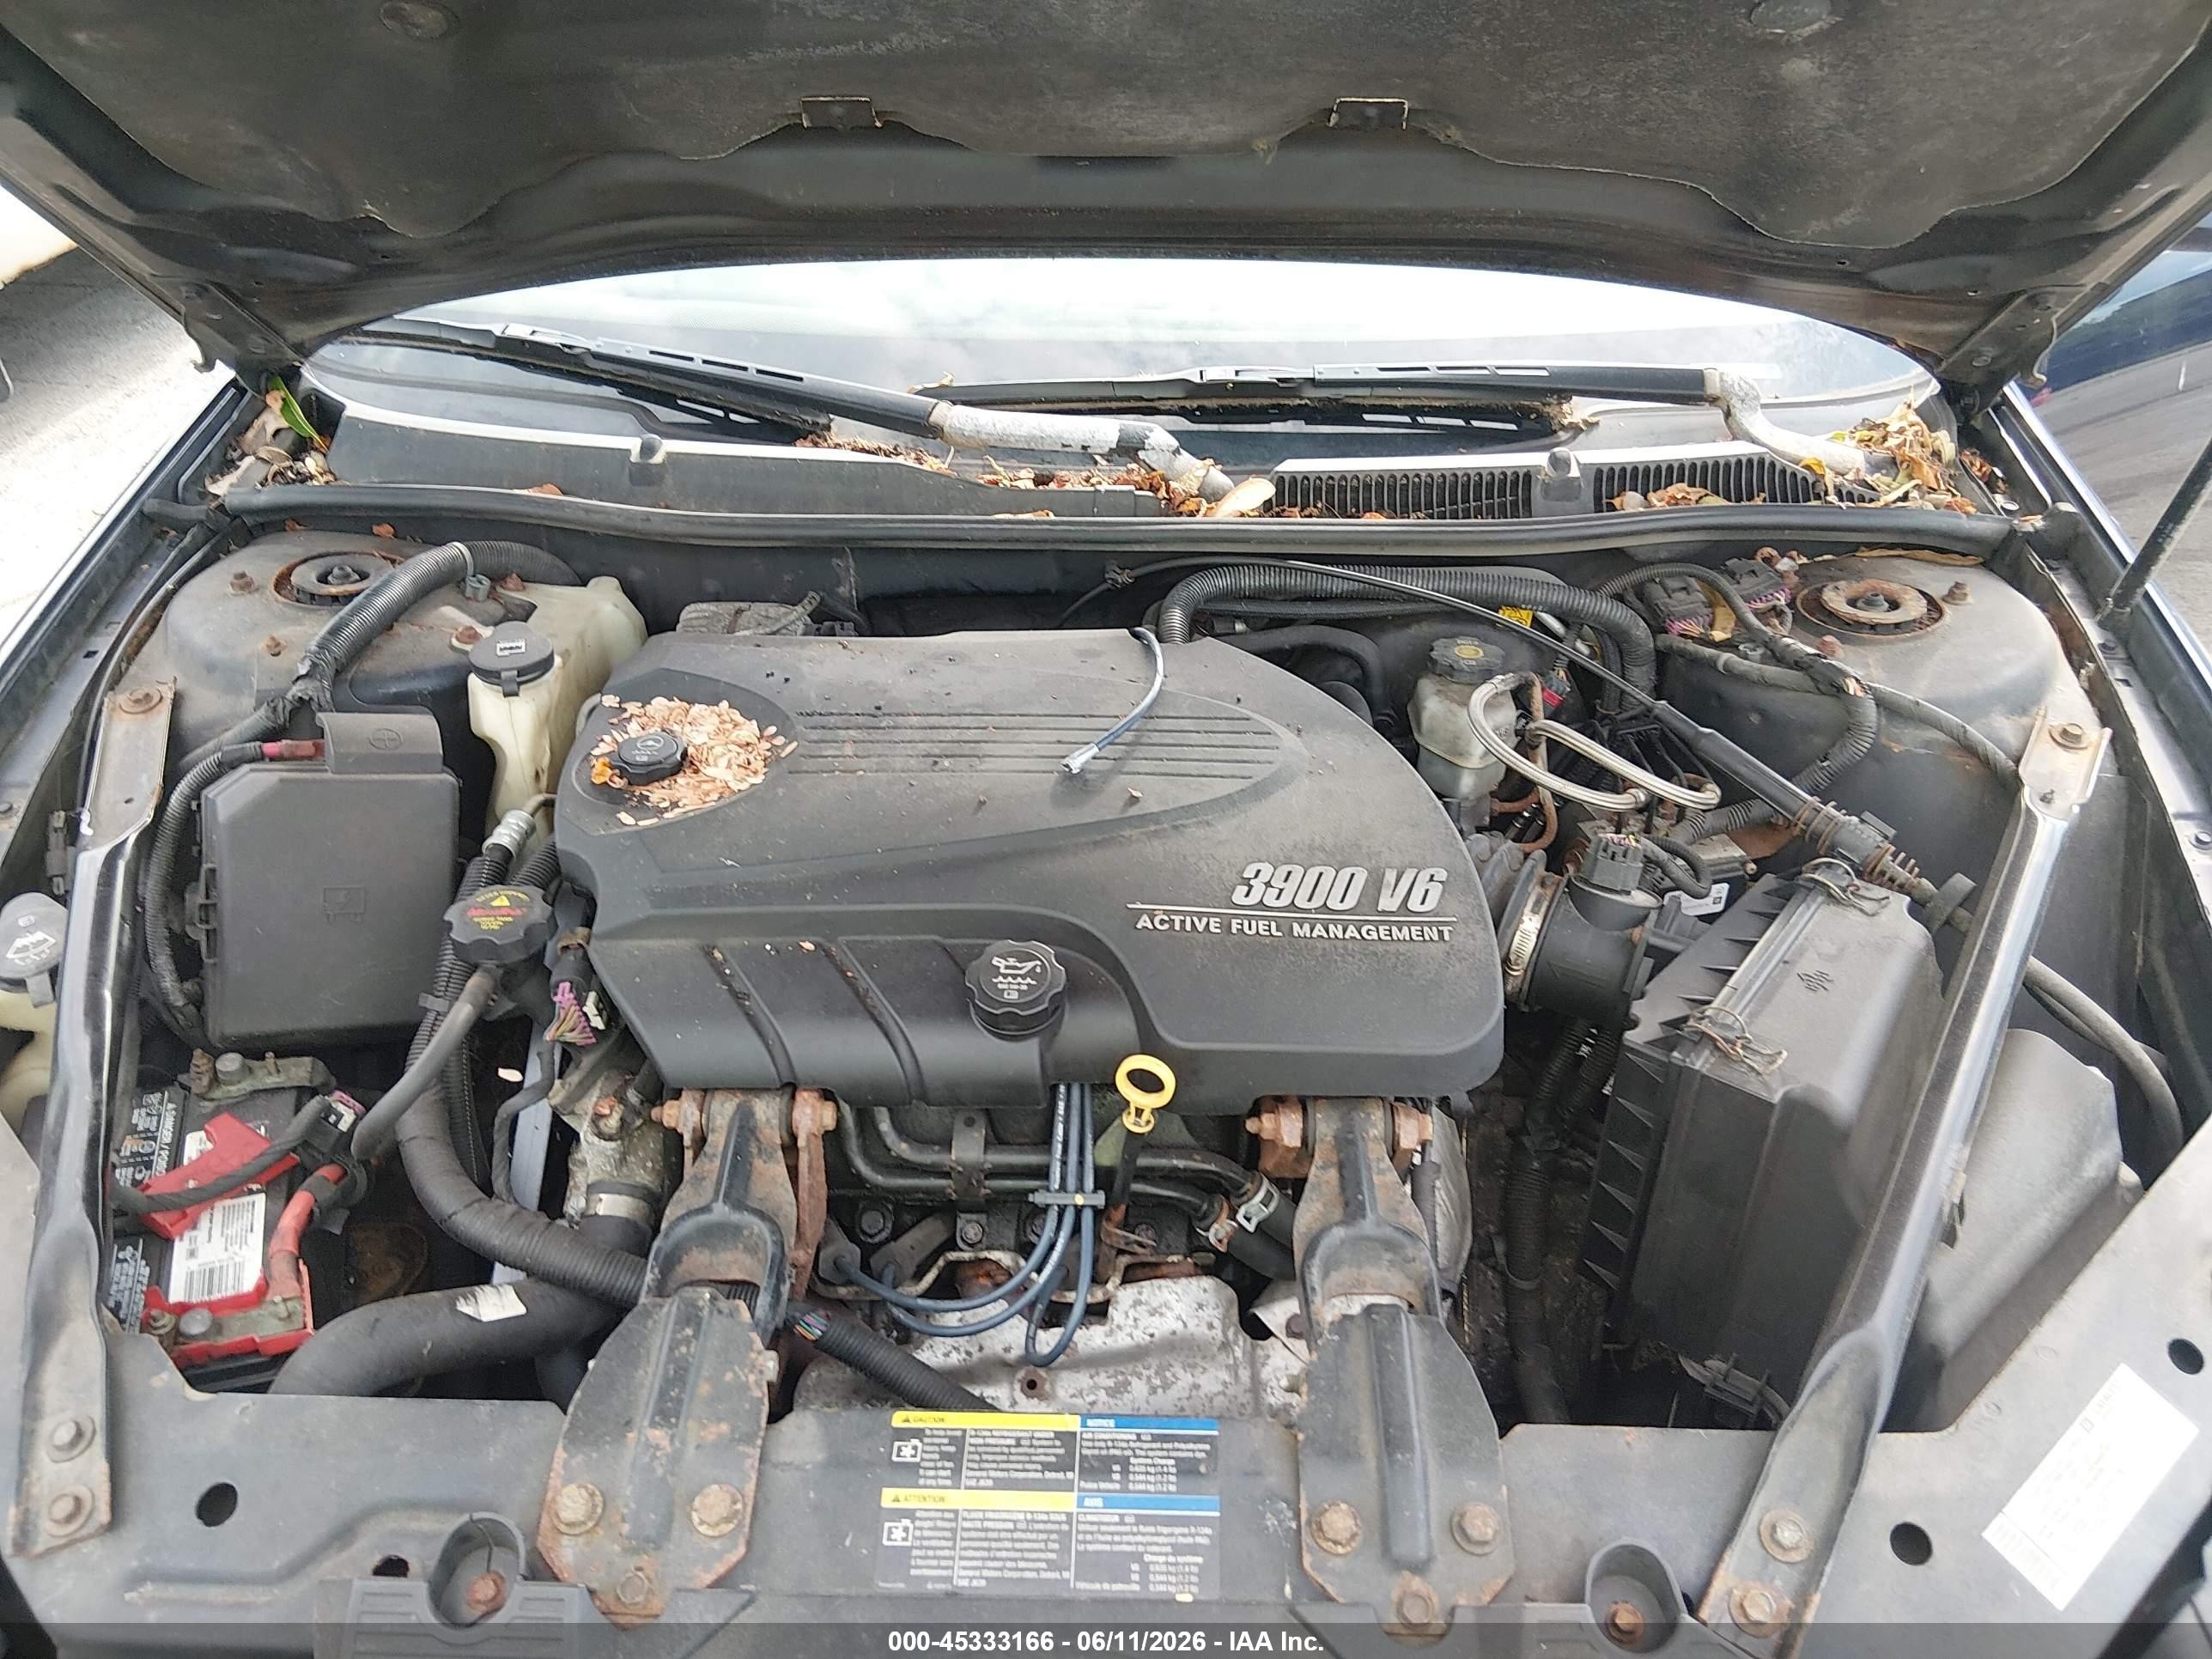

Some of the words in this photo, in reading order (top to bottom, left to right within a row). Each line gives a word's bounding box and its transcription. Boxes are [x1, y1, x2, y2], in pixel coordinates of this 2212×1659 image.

[1231, 862, 1368, 911] 3900
[1377, 866, 1449, 913] V6
[1134, 915, 1221, 934] ACTIVE
[1231, 918, 1284, 938] FUEL
[1292, 922, 1454, 943] MANAGEMENT
